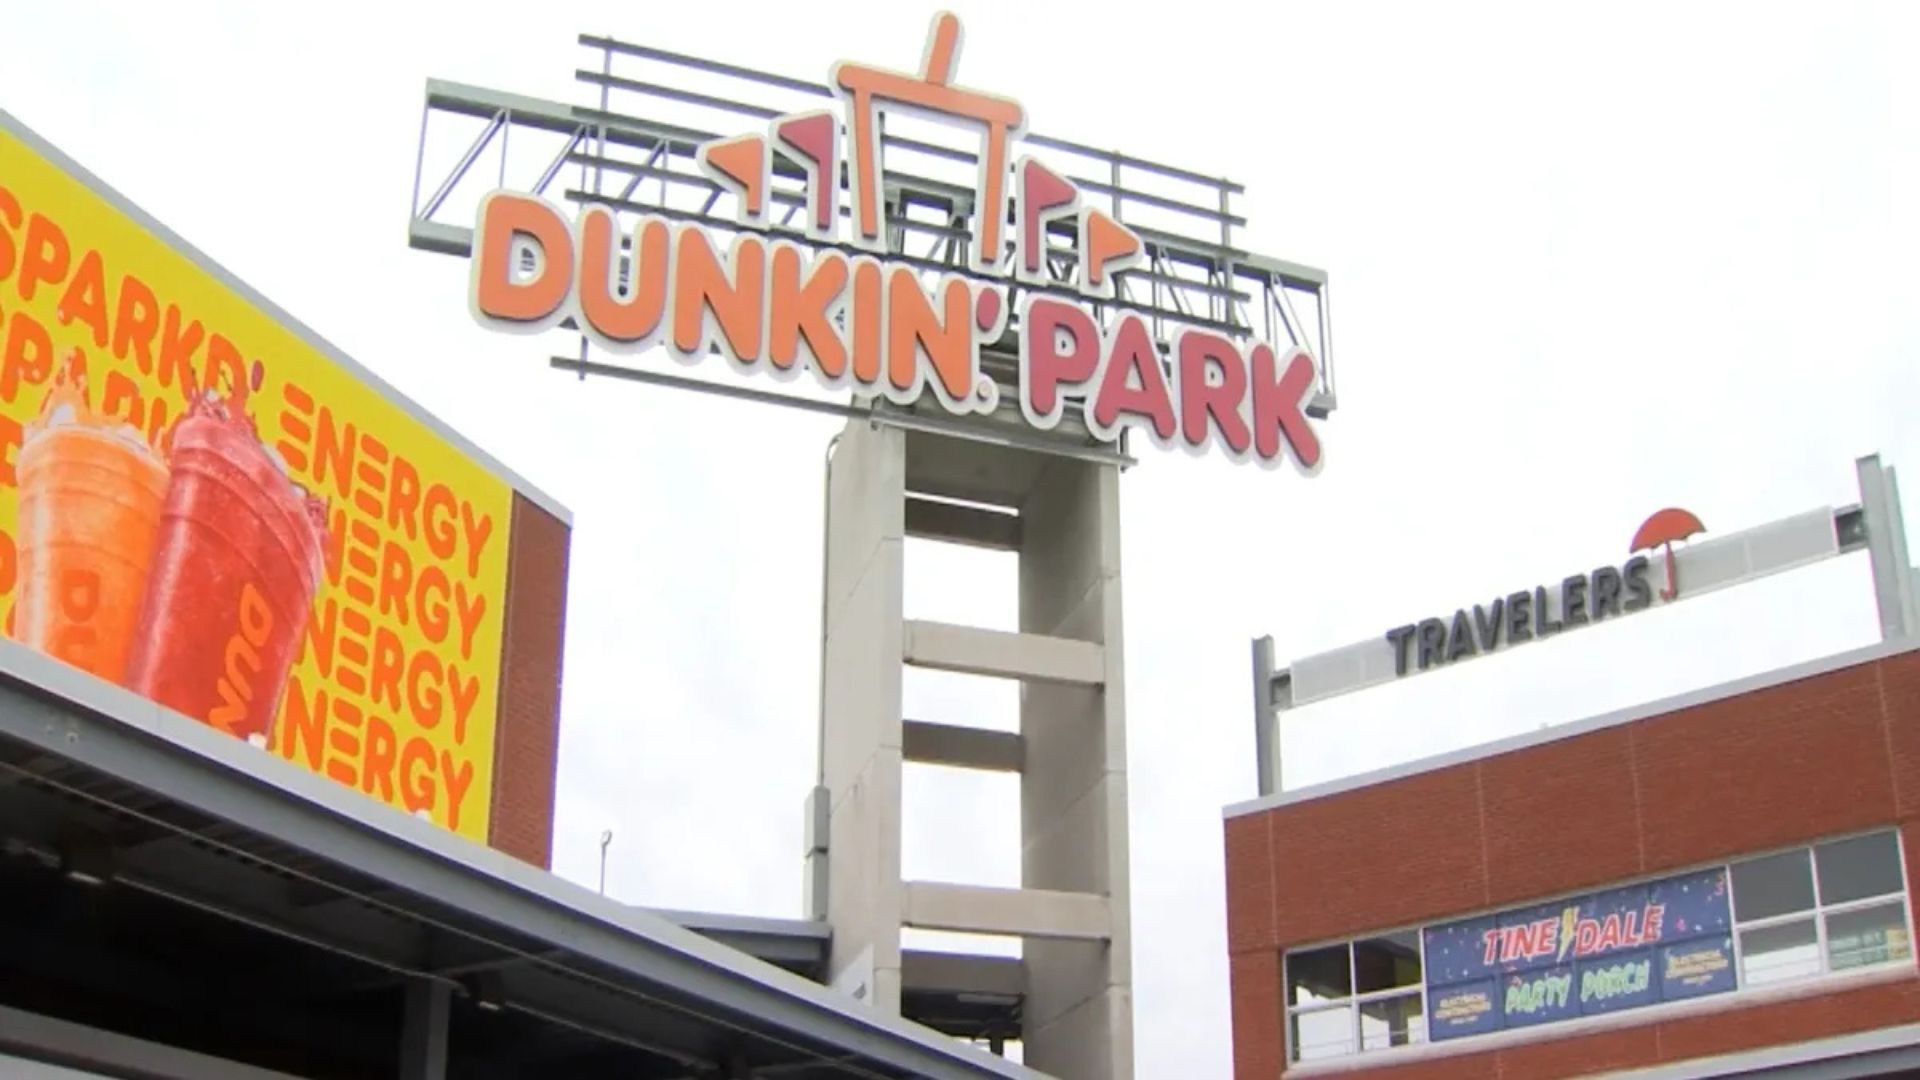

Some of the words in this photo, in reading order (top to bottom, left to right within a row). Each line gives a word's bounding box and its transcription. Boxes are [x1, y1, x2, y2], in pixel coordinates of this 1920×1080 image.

[477, 193, 999, 402] DUNKIN'
[1028, 299, 1320, 467] PARK
[277, 382, 493, 579] ENERGY
[322, 508, 486, 662] NERGY
[1386, 555, 1651, 679] TRAVELERS
[293, 597, 480, 746] NERGY
[268, 674, 474, 832] NERGY
[1504, 972, 1572, 1016] PARTY
